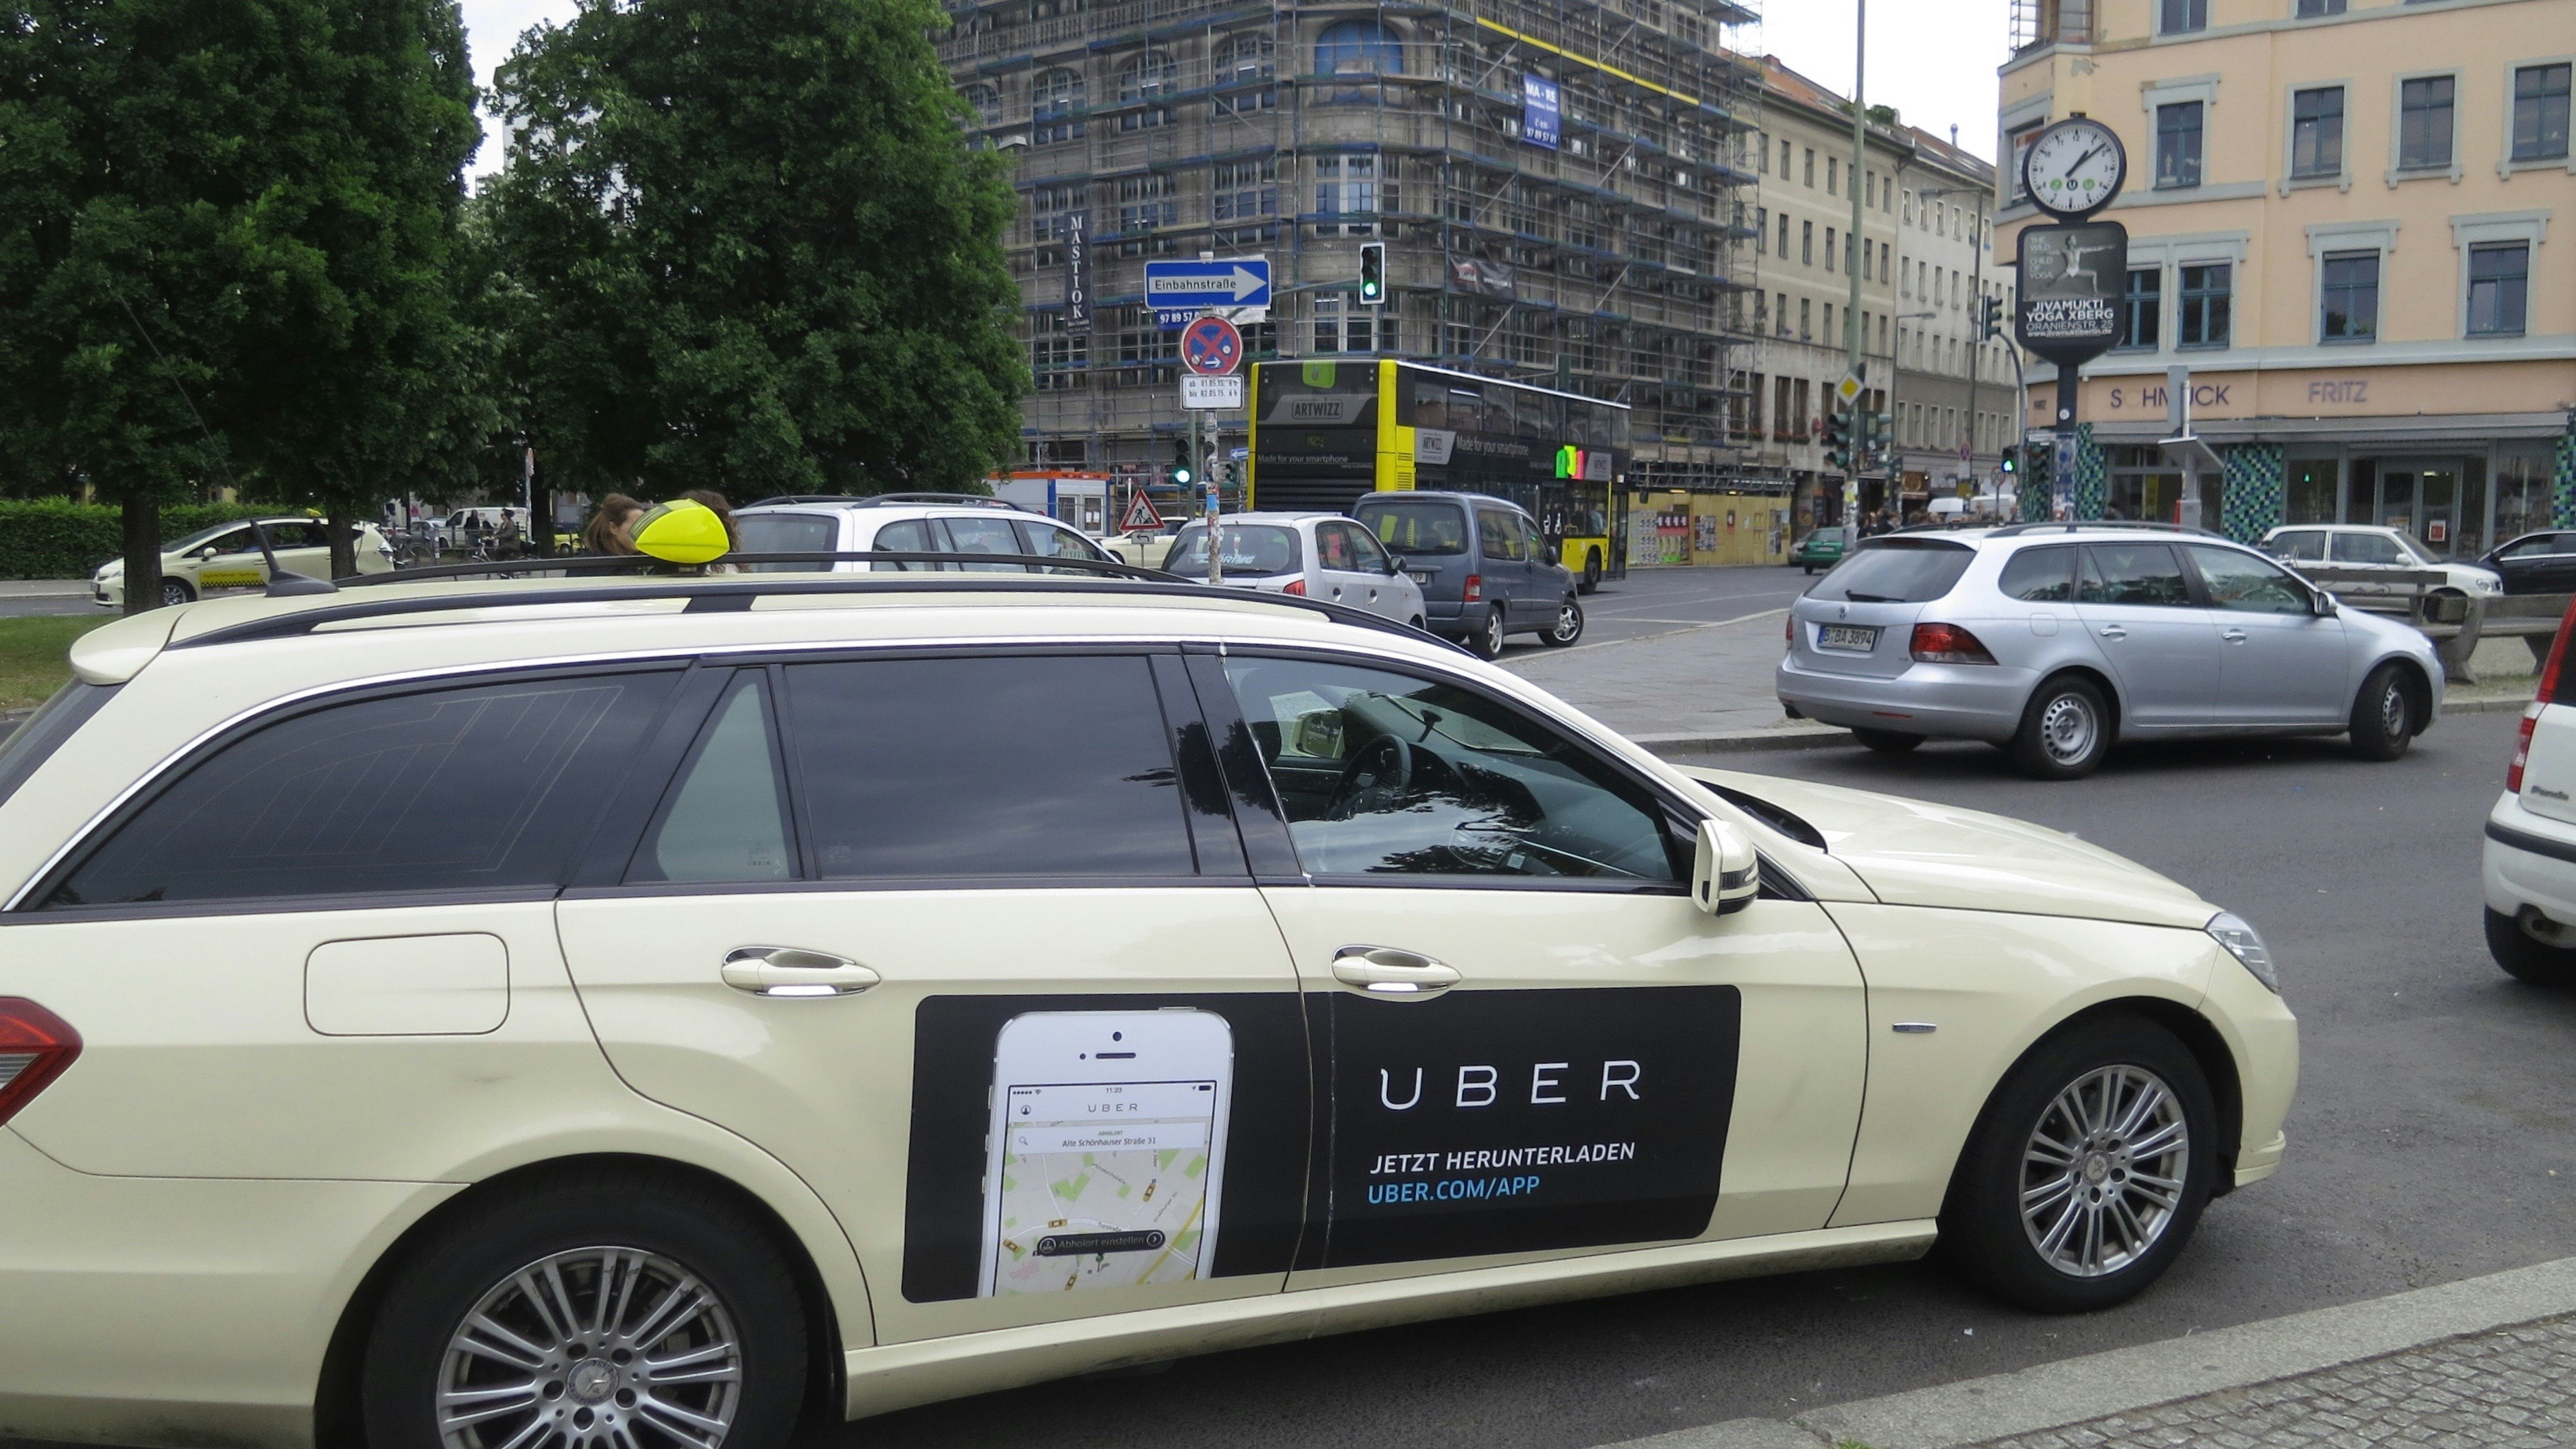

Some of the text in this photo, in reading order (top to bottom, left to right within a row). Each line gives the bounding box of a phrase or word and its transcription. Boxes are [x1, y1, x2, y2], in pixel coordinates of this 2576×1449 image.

[1071, 215, 1083, 319] MASTIOK
[1155, 279, 1237, 291] Einbahnstraße
[2033, 299, 2104, 312] JIVAMUKTI
[1159, 314, 1169, 324] 97
[1171, 312, 1181, 323] 89
[1183, 311, 1192, 322] 57
[2026, 308, 2114, 322] YOGA XBERG
[2101, 320, 2114, 329] 25
[2308, 380, 2367, 403] FRITZ
[1456, 434, 1529, 458] Made for your smartphone
[1257, 454, 1349, 464] Made for your smartphone
[1380, 1060, 1641, 1110] UBER
[1087, 1103, 1139, 1113] UBER
[1078, 1138, 1122, 1146] Schönhauser
[1370, 1142, 1635, 1175] JETZT HERUNTERLADEN
[1367, 1175, 1541, 1205] UBER.COM/APP
[1059, 1236, 1145, 1248] Abholort einstellen
